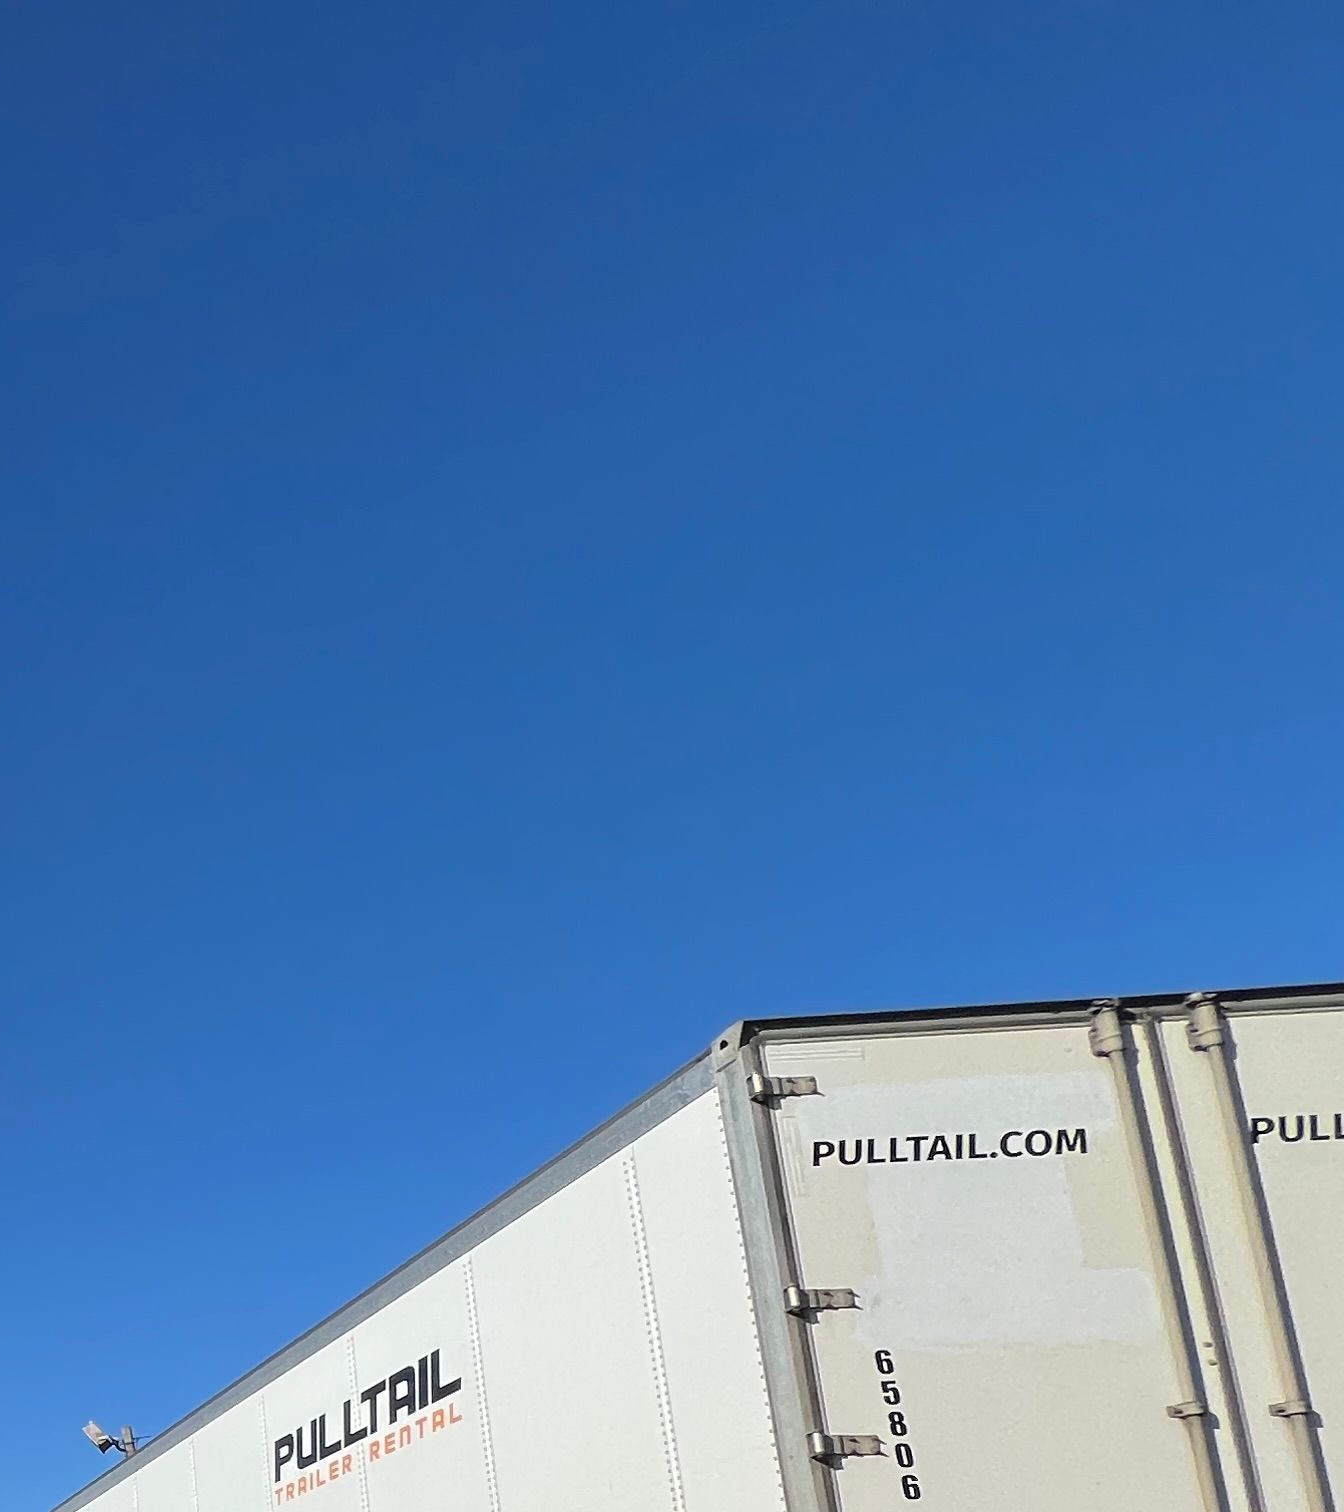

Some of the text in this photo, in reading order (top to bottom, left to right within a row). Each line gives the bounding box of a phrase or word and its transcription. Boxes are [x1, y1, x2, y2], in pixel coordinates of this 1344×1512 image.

[813, 1129, 1088, 1166] PULLTAIL.COM
[274, 1349, 462, 1483] PULLTAIL
[274, 1402, 463, 1506] TRAILER RENTAL
